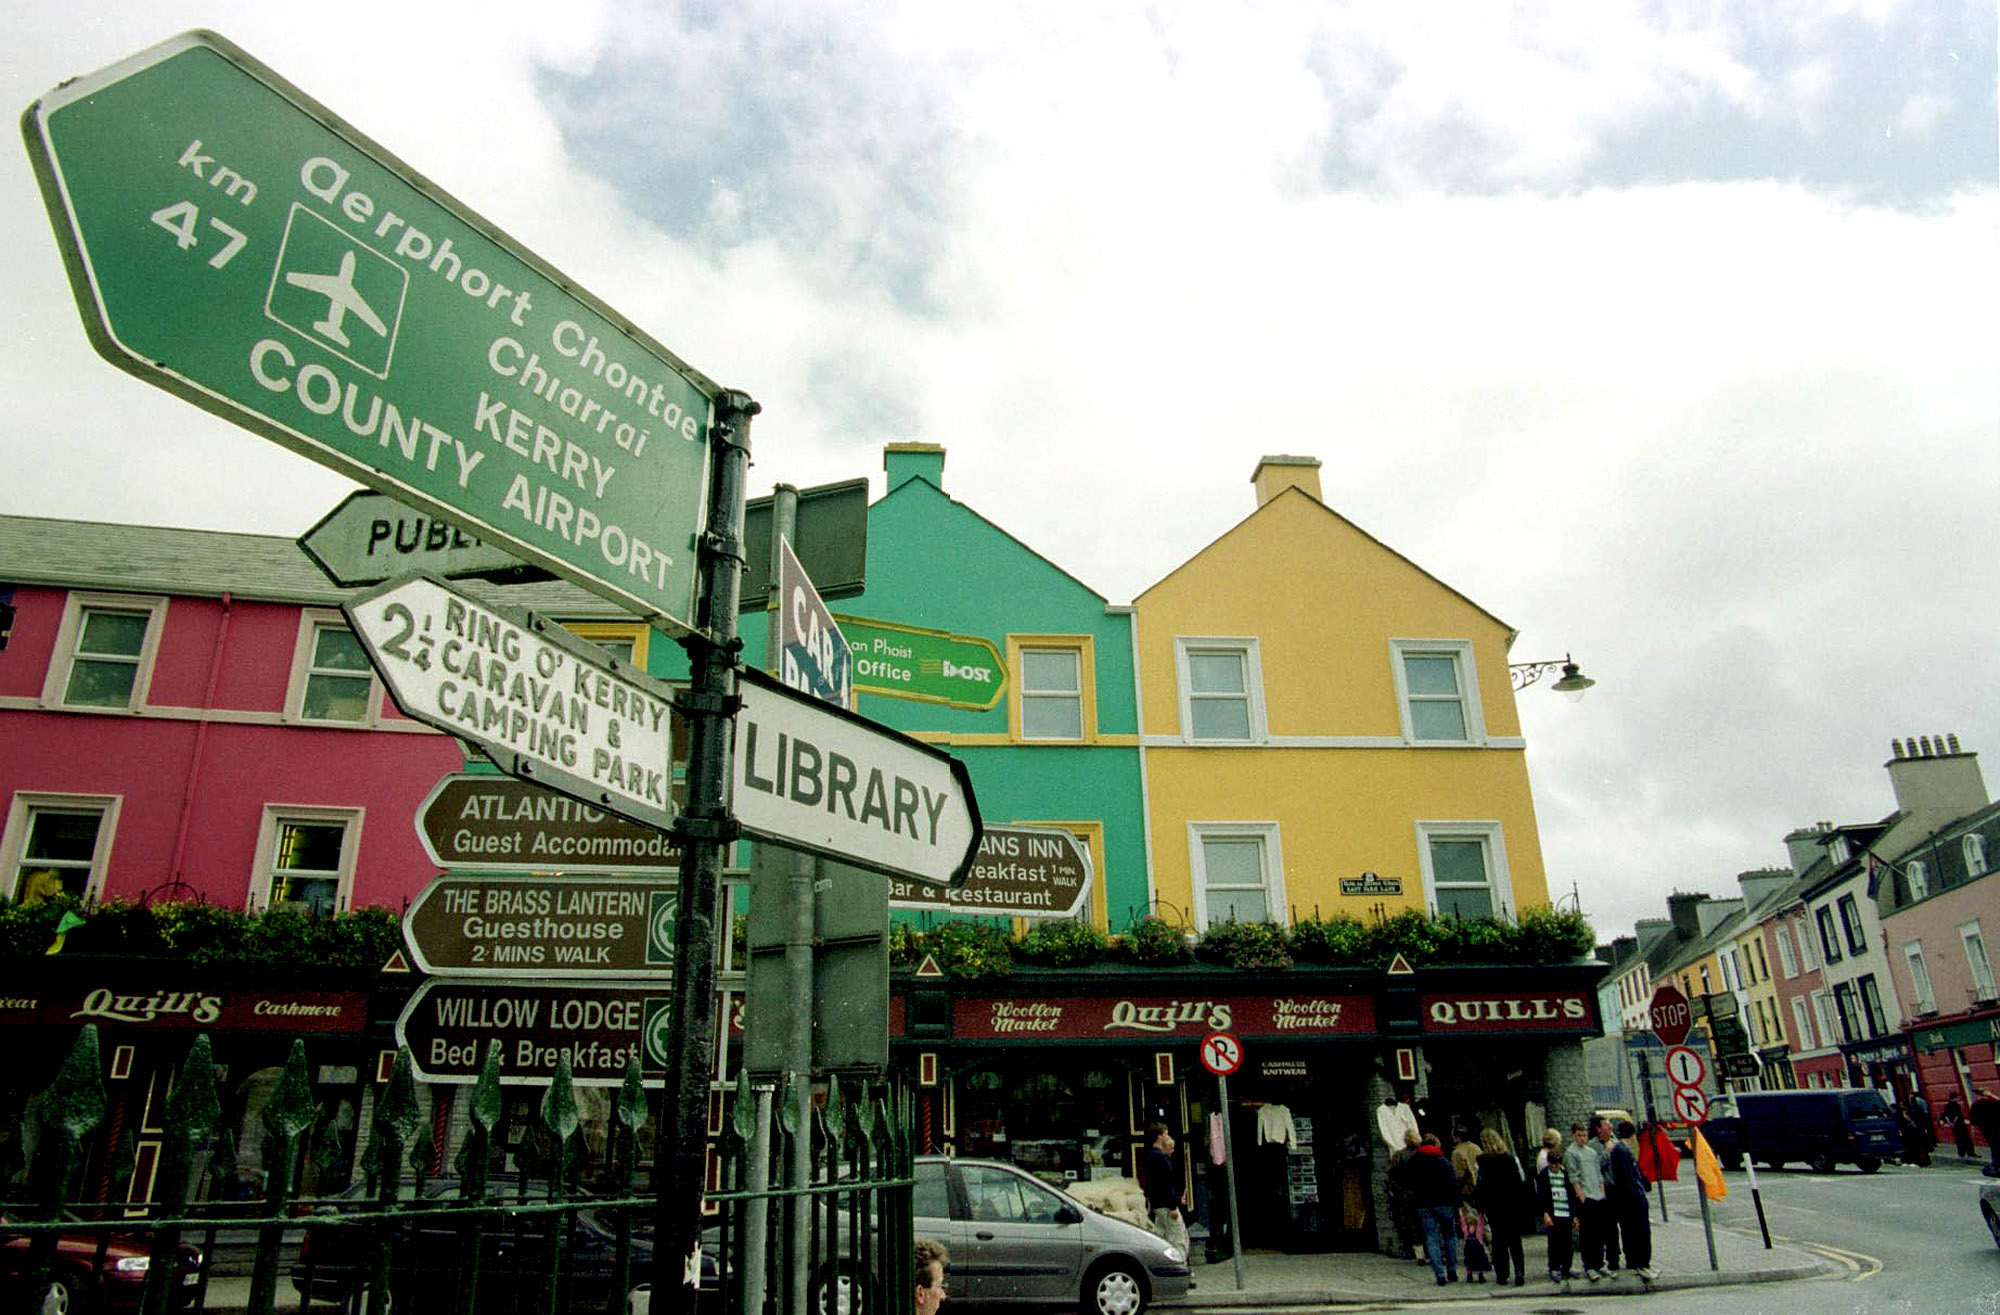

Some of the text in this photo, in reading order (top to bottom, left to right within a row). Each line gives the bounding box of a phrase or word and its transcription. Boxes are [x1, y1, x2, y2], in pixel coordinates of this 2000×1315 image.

[178, 139, 260, 207] km
[150, 200, 249, 270] 47
[552, 319, 700, 444] Chontae
[249, 339, 616, 501] COUNTY KERRY
[366, 518, 483, 556] PUBL
[502, 474, 674, 591] AIRPORT
[793, 585, 835, 692] CAR
[851, 638, 913, 659] an Phoist
[445, 600, 521, 662] RING
[574, 662, 665, 732] KERRY
[857, 659, 912, 682] Office
[442, 639, 622, 749] CARAVAN &
[438, 680, 663, 805] CAMPING PARK
[744, 722, 948, 846] LIBRARY
[453, 828, 682, 857] Guest Accommoda
[978, 836, 1063, 859] ANS INN
[923, 886, 935, 899] &
[1053, 876, 1077, 887] WALK
[443, 889, 645, 916] THE BRASS LANTERN
[462, 916, 624, 940] Guesthouse
[493, 946, 545, 963] MINS
[554, 947, 611, 964] WALK
[70, 988, 222, 1024] Quill's
[253, 1000, 342, 1018] Cashmere
[436, 998, 641, 1031] WILLOW LODGE
[992, 1001, 1062, 1017] Woollen
[1104, 1001, 1232, 1031] Quill's
[1273, 999, 1341, 1015] Woollen
[1430, 998, 1586, 1024] QUILL'S
[1652, 1003, 1687, 1028] STOP
[990, 1016, 1059, 1033] Market
[1272, 1014, 1339, 1031] Market
[431, 1038, 477, 1066] Bed
